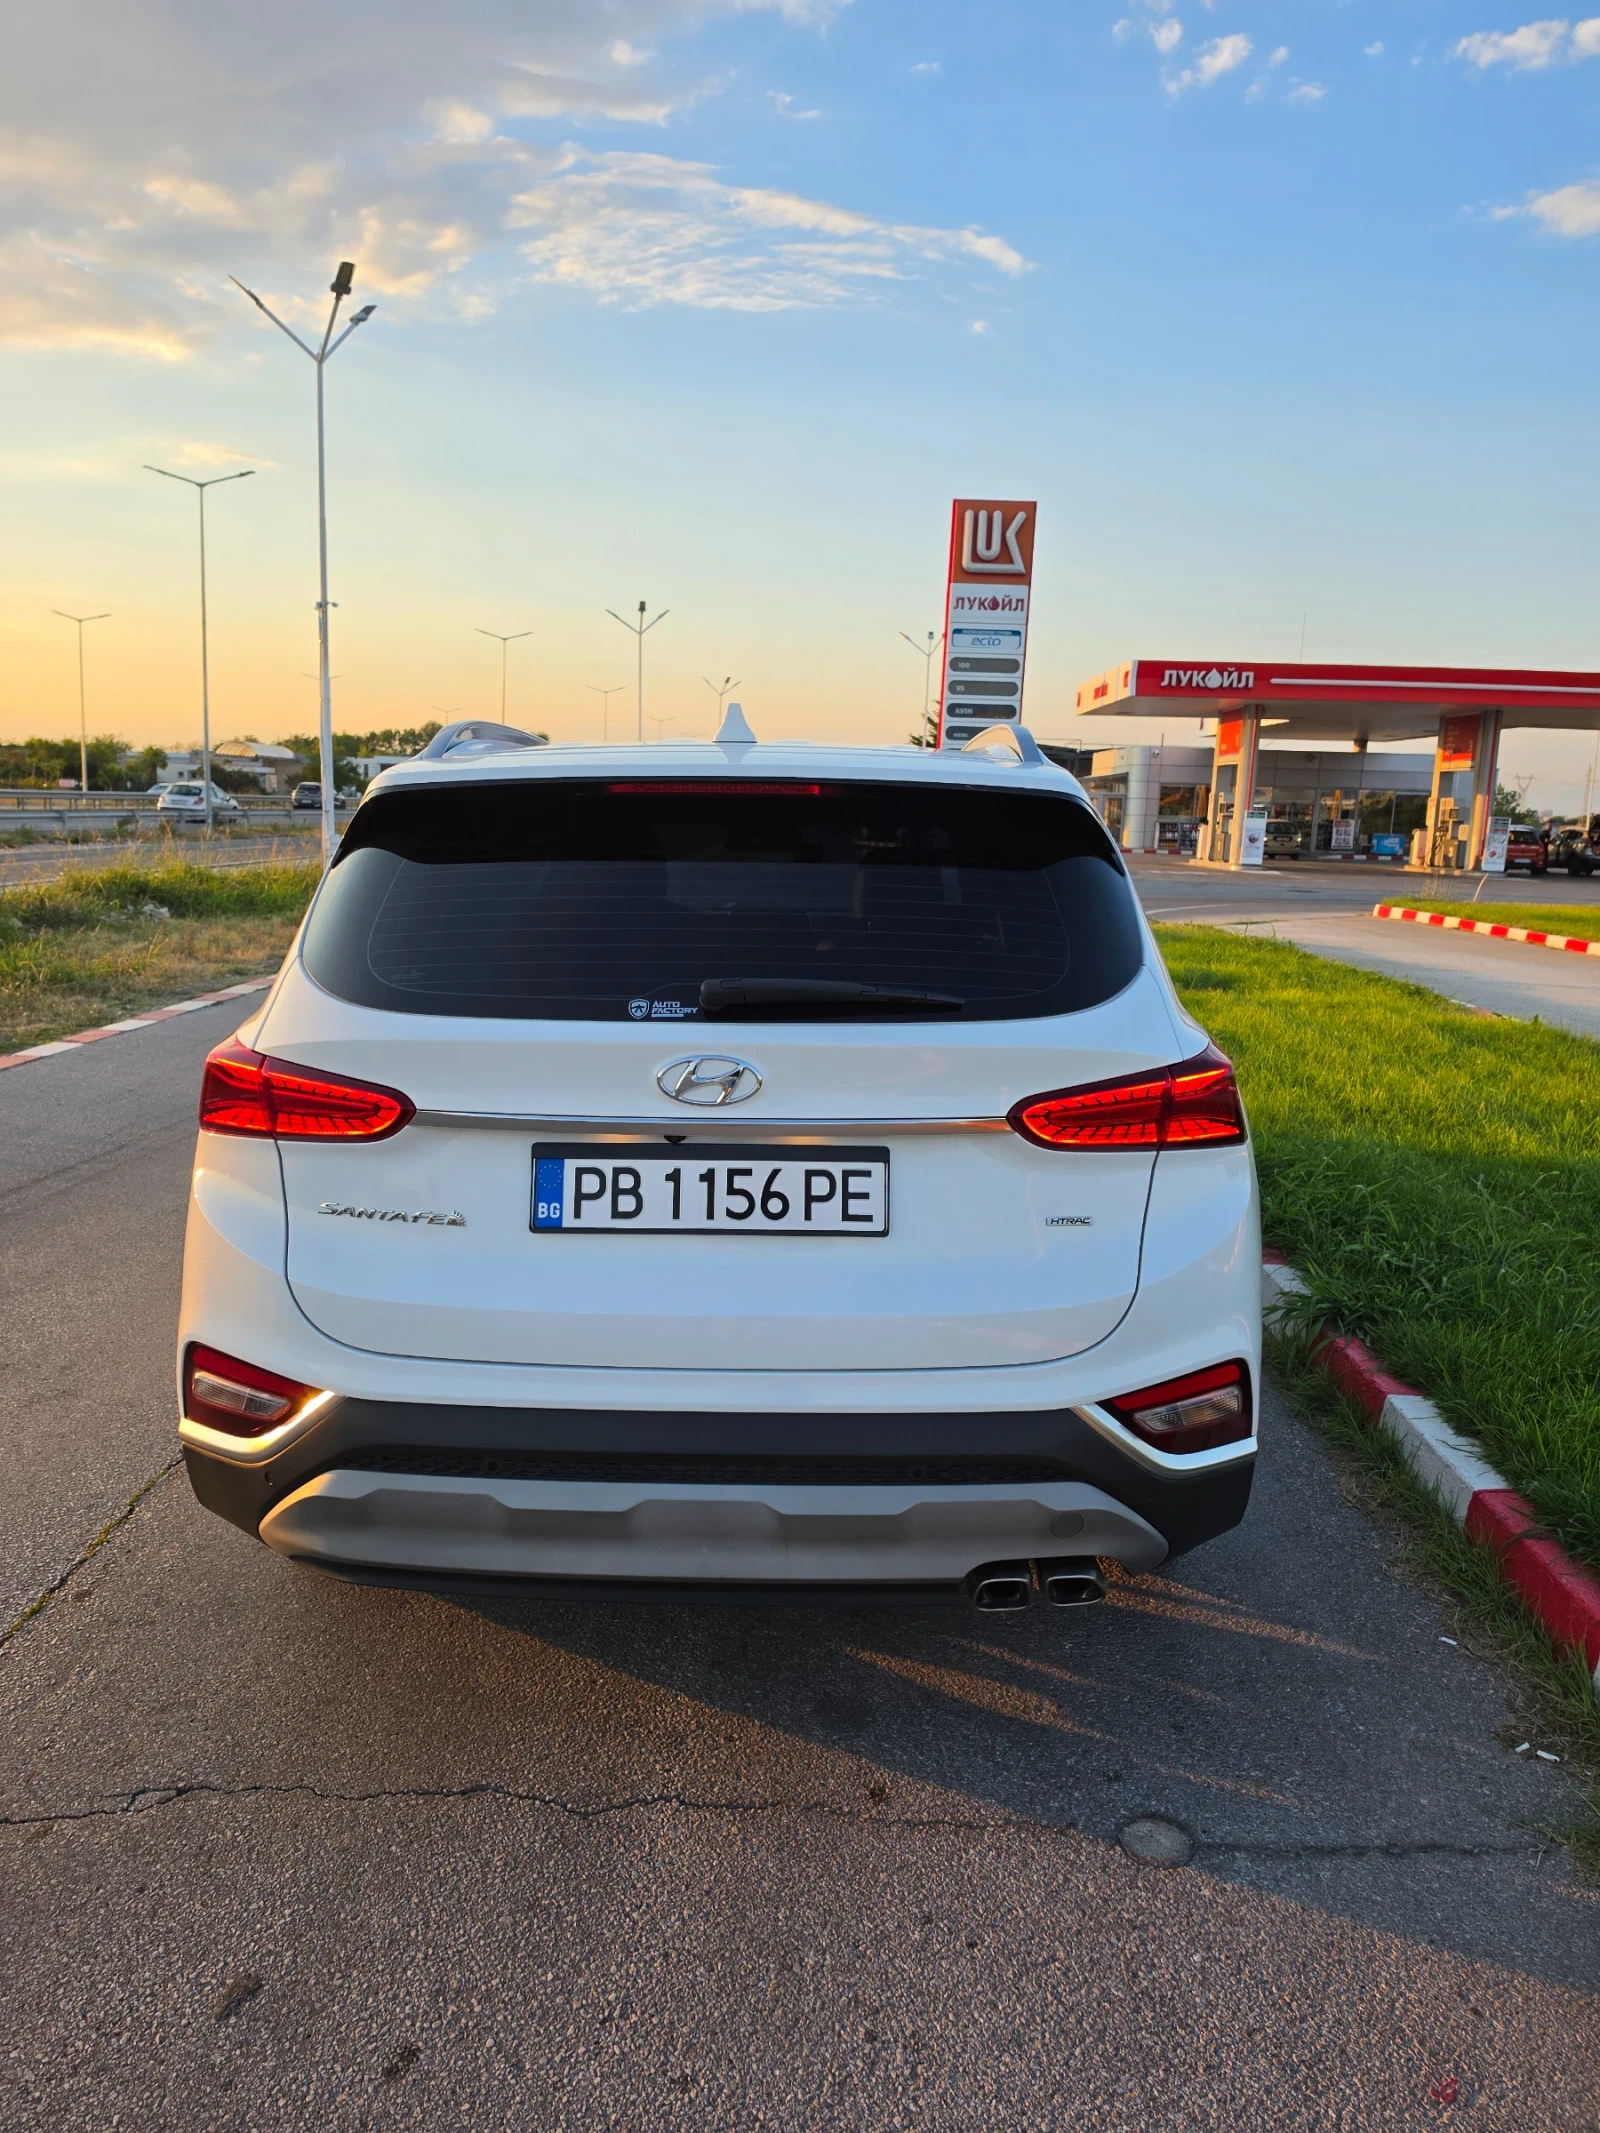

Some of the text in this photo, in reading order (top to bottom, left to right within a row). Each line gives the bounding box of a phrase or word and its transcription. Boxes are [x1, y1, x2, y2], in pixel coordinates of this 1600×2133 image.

[953, 595, 1025, 612] ЛУКОЙЛ
[971, 636, 1002, 647] ecto
[1160, 667, 1254, 689] ЛУКОЙЛ
[652, 1000, 681, 1008] AUTO
[573, 1166, 874, 1222] PB 1156 PE
[537, 1202, 561, 1219] BG
[1050, 1217, 1092, 1225] HTRAC
